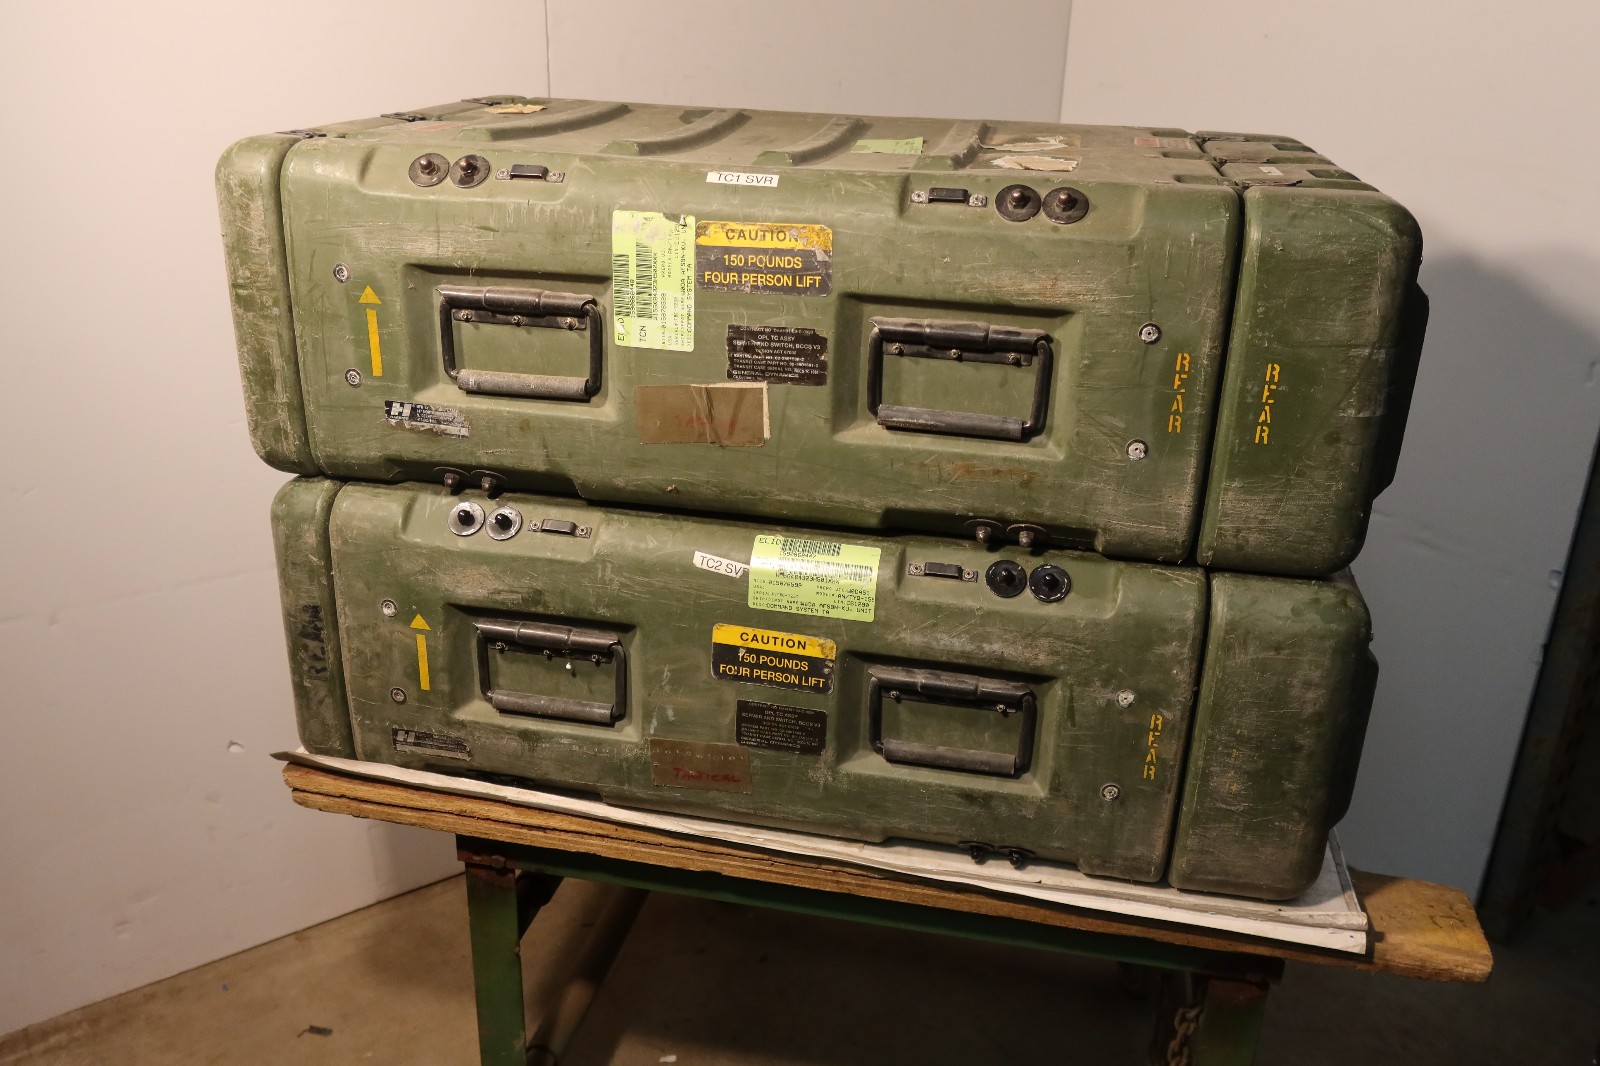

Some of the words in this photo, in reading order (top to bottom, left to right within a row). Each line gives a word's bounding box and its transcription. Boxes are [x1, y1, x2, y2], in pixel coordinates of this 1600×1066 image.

[715, 173, 741, 183] TC1
[745, 174, 774, 185] SVR
[725, 228, 800, 243] CAUTION
[687, 263, 692, 272] TA
[723, 254, 745, 267] 150
[748, 254, 802, 269] POUNDS
[704, 271, 739, 285] FOUR
[741, 273, 793, 287] PERSON
[795, 274, 822, 288] LIFT
[1168, 353, 1190, 433] REAR
[1254, 363, 1281, 445] REAR
[699, 555, 722, 570] TC2
[740, 632, 807, 650] CAUTION
[738, 652, 757, 664] 150
[759, 654, 809, 671] POUNDS
[719, 664, 750, 678] FOUR
[753, 668, 799, 684] PERSON
[802, 677, 826, 688] LIFT
[1143, 714, 1163, 781] REAR
